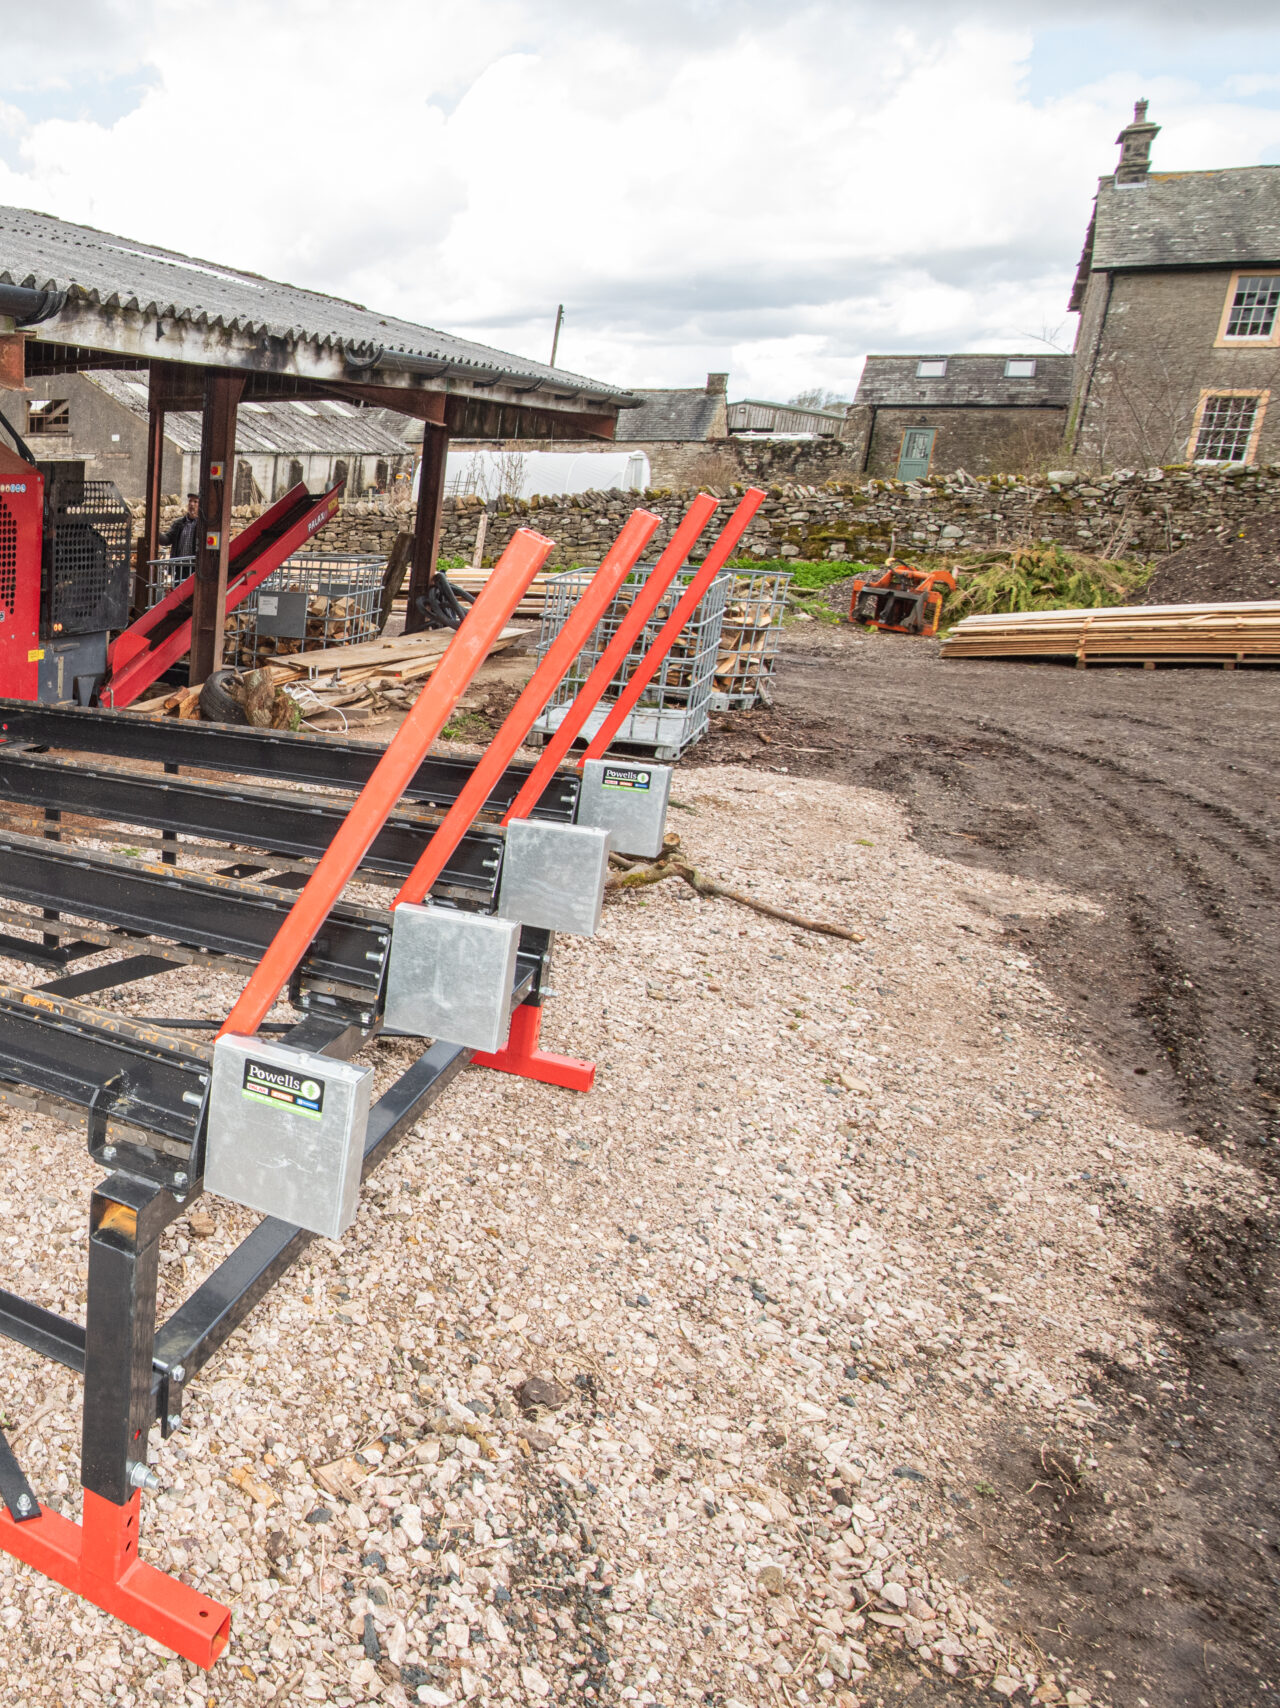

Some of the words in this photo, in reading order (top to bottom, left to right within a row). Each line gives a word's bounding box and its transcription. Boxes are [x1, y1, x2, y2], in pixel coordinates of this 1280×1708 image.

[308, 511, 325, 532] PALAX
[607, 770, 637, 779] Powells
[249, 1064, 300, 1089] Powells
